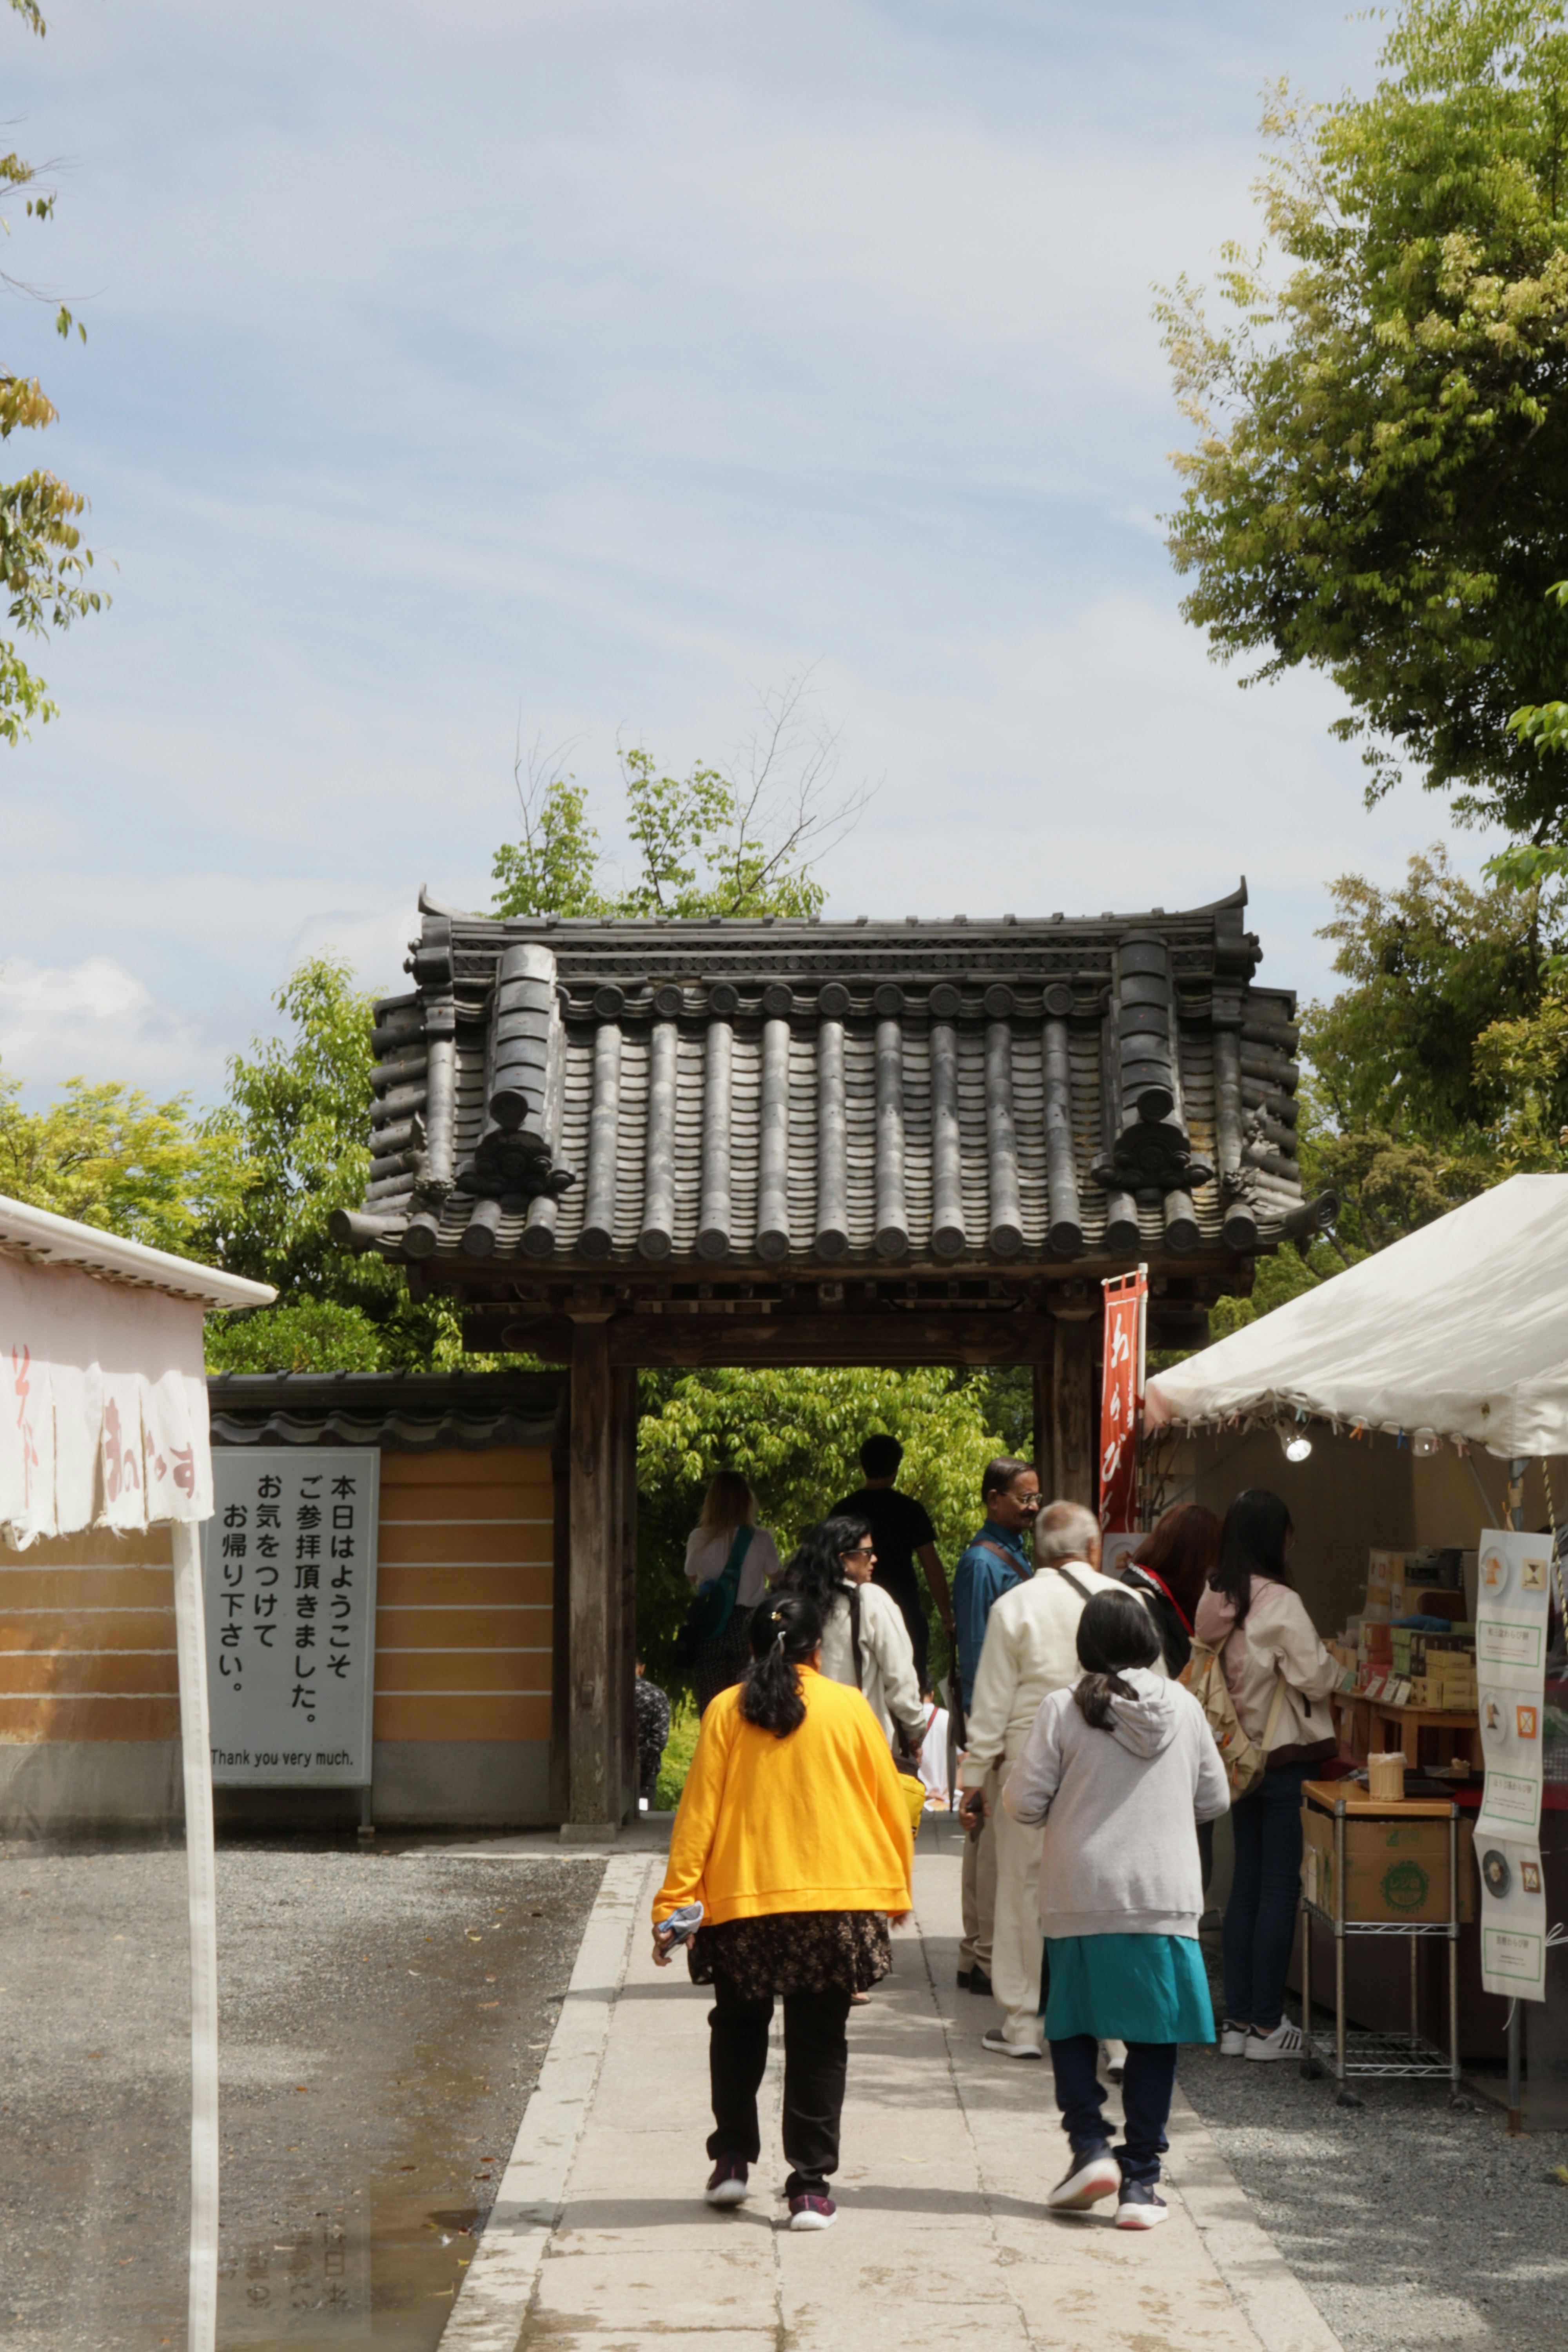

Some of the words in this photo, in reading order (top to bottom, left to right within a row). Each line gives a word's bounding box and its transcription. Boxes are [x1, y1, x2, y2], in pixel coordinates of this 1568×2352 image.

[220, 1504, 247, 1691] お帰り下さい。
[254, 1475, 282, 1647] お気をつけて
[292, 1475, 323, 1722] ご参拝頂きました。
[327, 1475, 356, 1678] 本日はようこそ
[212, 1749, 249, 1765] Thank
[254, 1753, 278, 1768] you
[283, 1753, 311, 1768] very
[316, 1750, 353, 1766] much.
